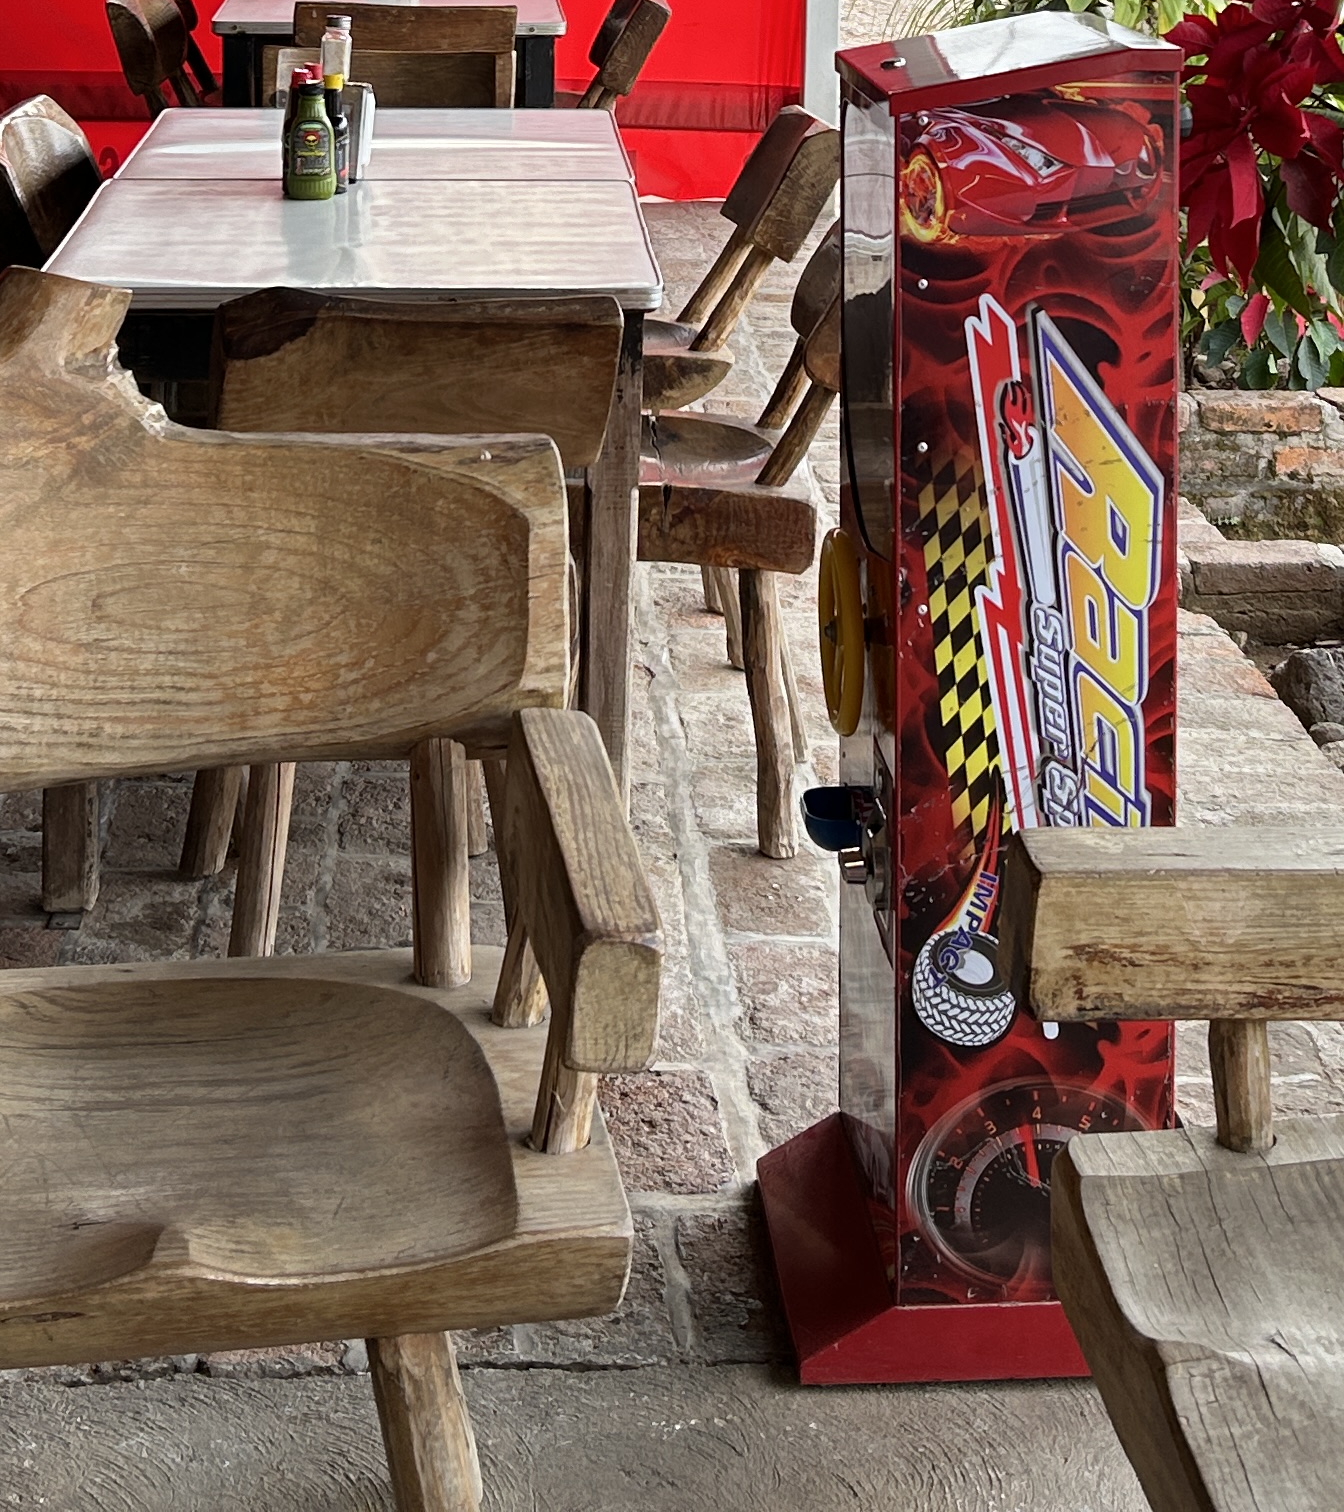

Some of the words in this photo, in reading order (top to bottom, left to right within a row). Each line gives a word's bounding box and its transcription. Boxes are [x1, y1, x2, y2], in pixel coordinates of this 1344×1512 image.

[1036, 310, 1166, 828] Raci
[928, 870, 999, 989] IMPACT
[1031, 1106, 1042, 1120] 4
